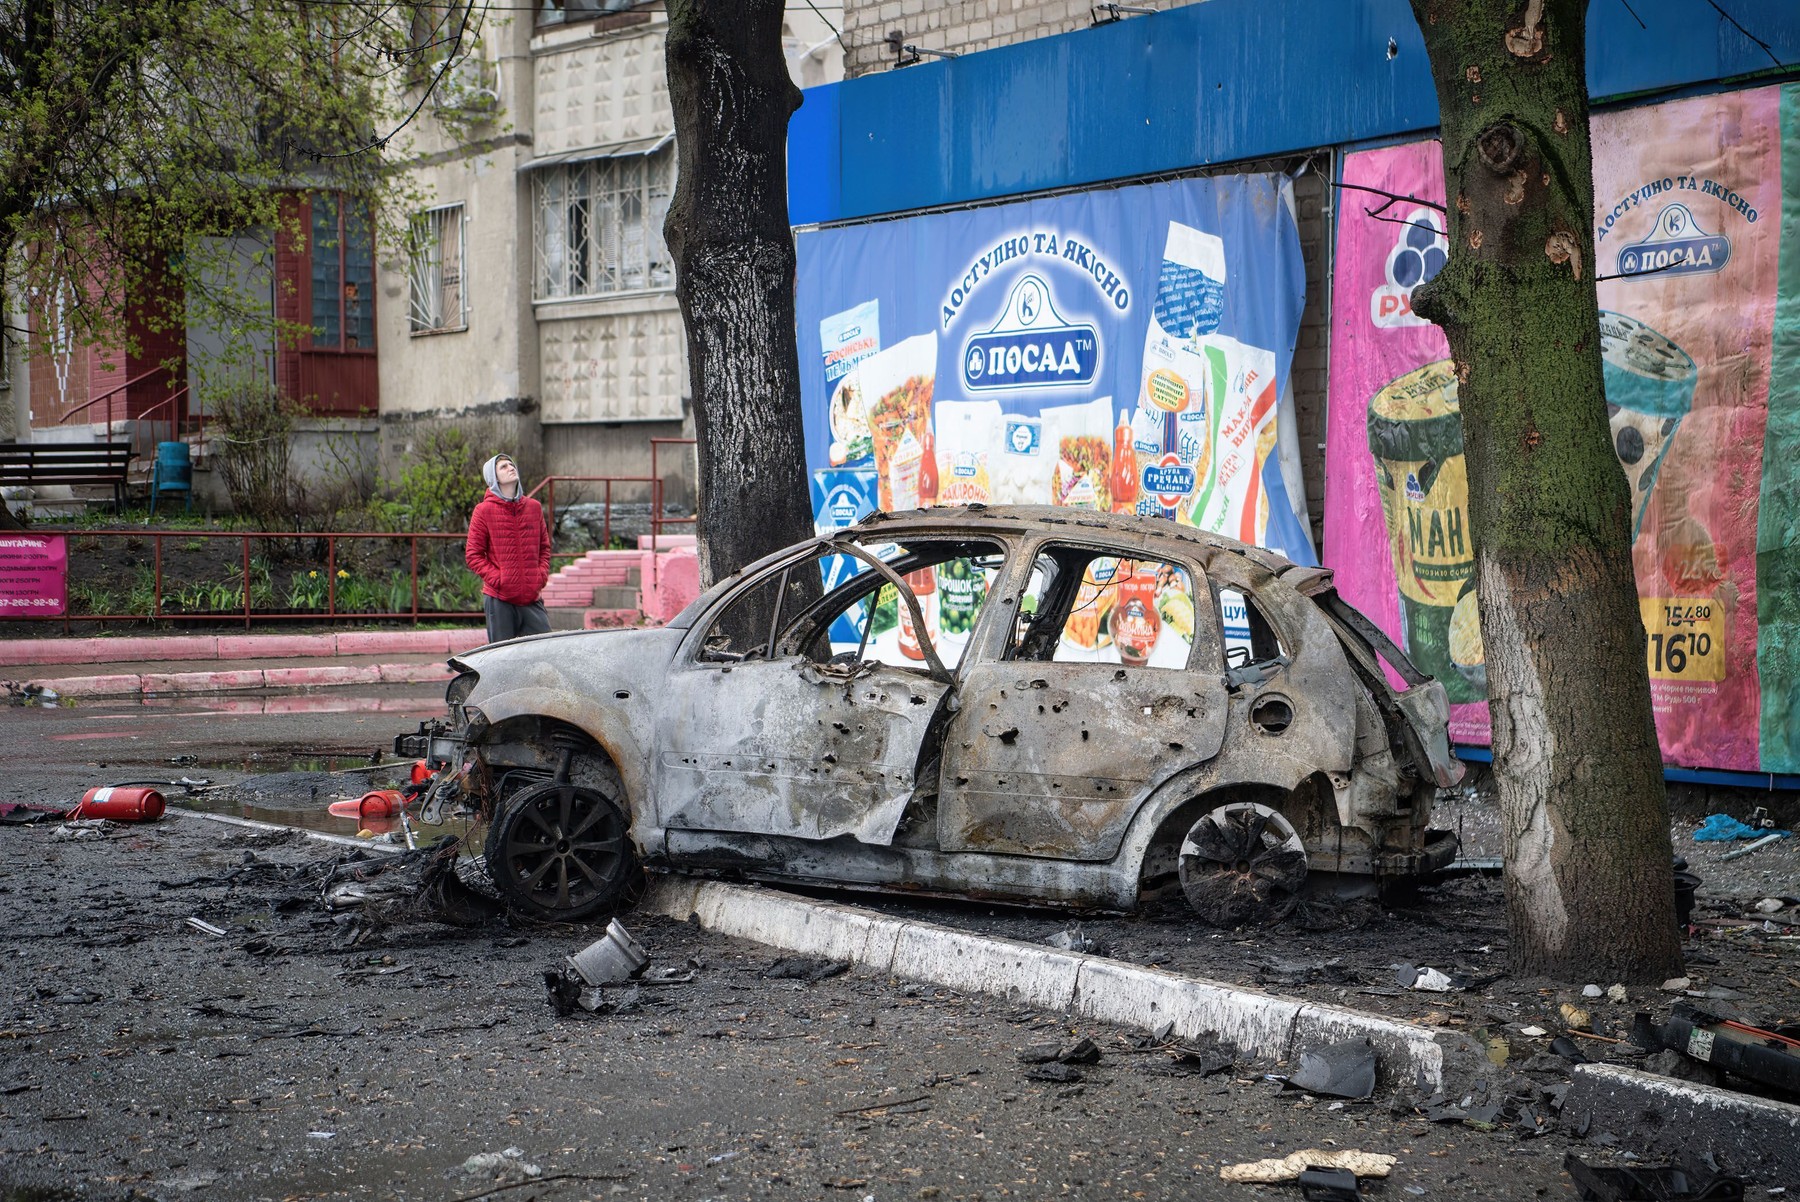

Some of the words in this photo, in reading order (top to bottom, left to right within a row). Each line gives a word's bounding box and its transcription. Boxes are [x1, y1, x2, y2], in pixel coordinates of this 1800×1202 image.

[1597, 176, 1674, 242] ДОСТУПНО
[1677, 176, 1697, 191] ТА
[1701, 179, 1758, 224] ЯКІСНО
[1640, 245, 1713, 271] ПОСАД
[942, 235, 1029, 328] ДОСТУПНО
[1033, 233, 1058, 255] ТА
[1062, 239, 1129, 310] ЯКІСНО
[988, 341, 1080, 376] ПОСАД
[1148, 473, 1190, 484] ГРЕЧАНА
[1647, 633, 1687, 674] 16
